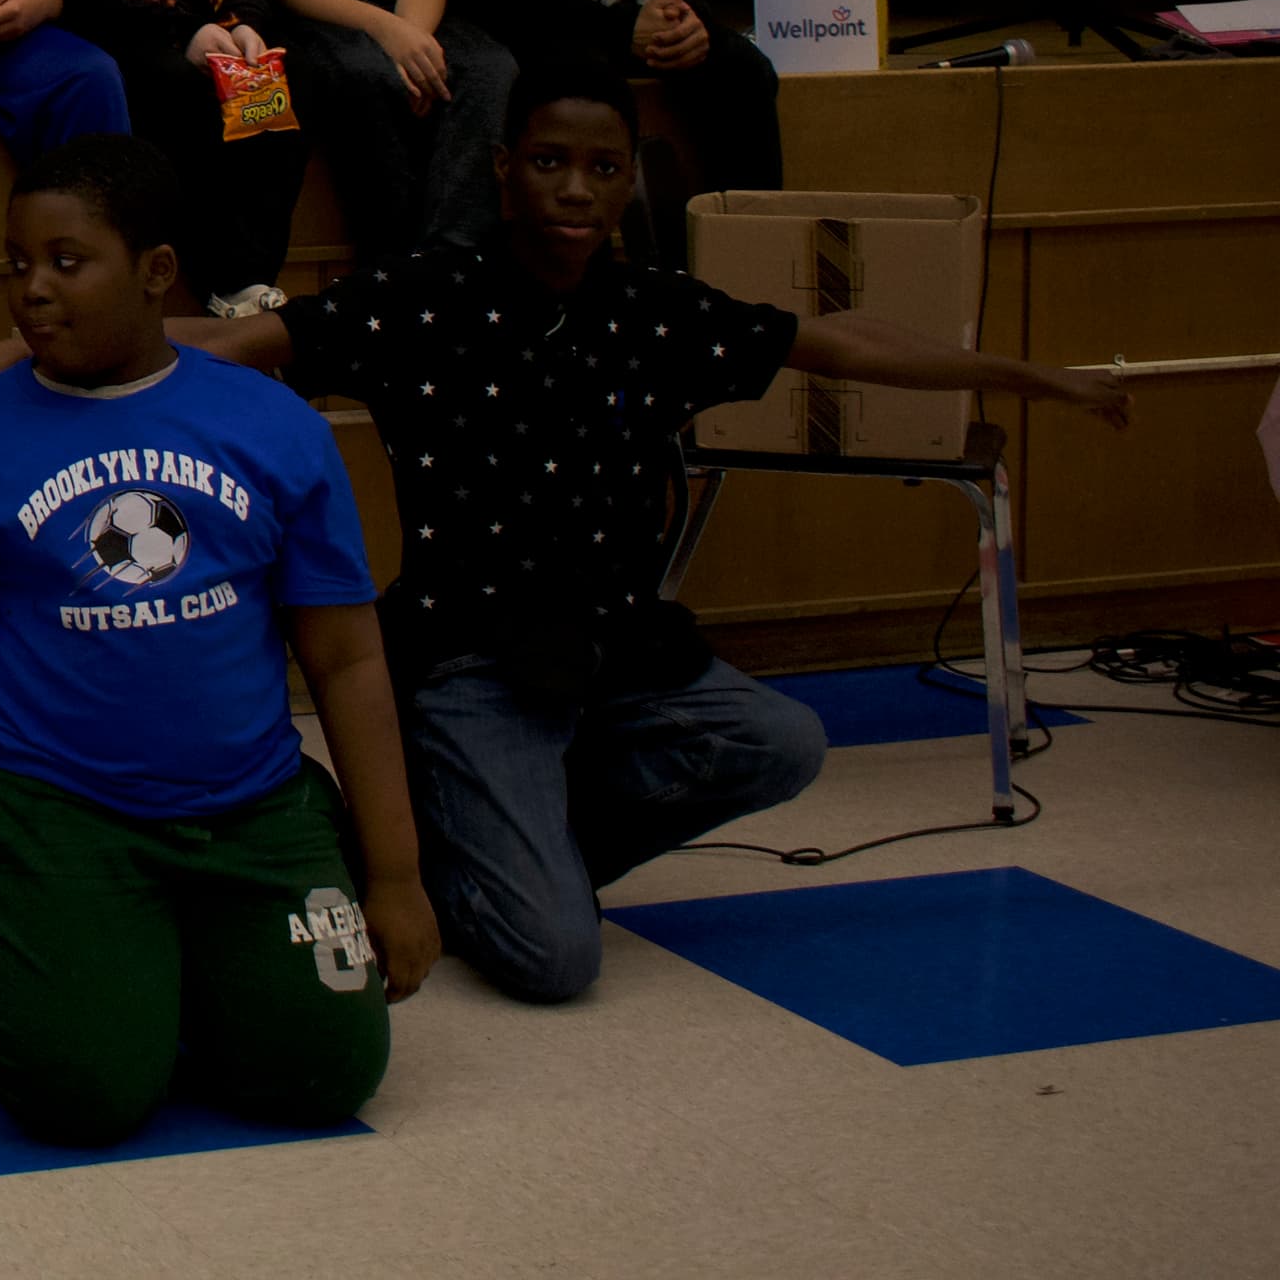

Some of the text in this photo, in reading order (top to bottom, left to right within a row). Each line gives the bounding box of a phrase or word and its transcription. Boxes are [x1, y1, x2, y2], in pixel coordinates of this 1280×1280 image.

[768, 18, 867, 42] Wellpoint
[242, 91, 286, 122] Cheetos
[17, 448, 251, 542] BROOKLYN PARK ES
[59, 580, 239, 632] FUTSAL CLUB
